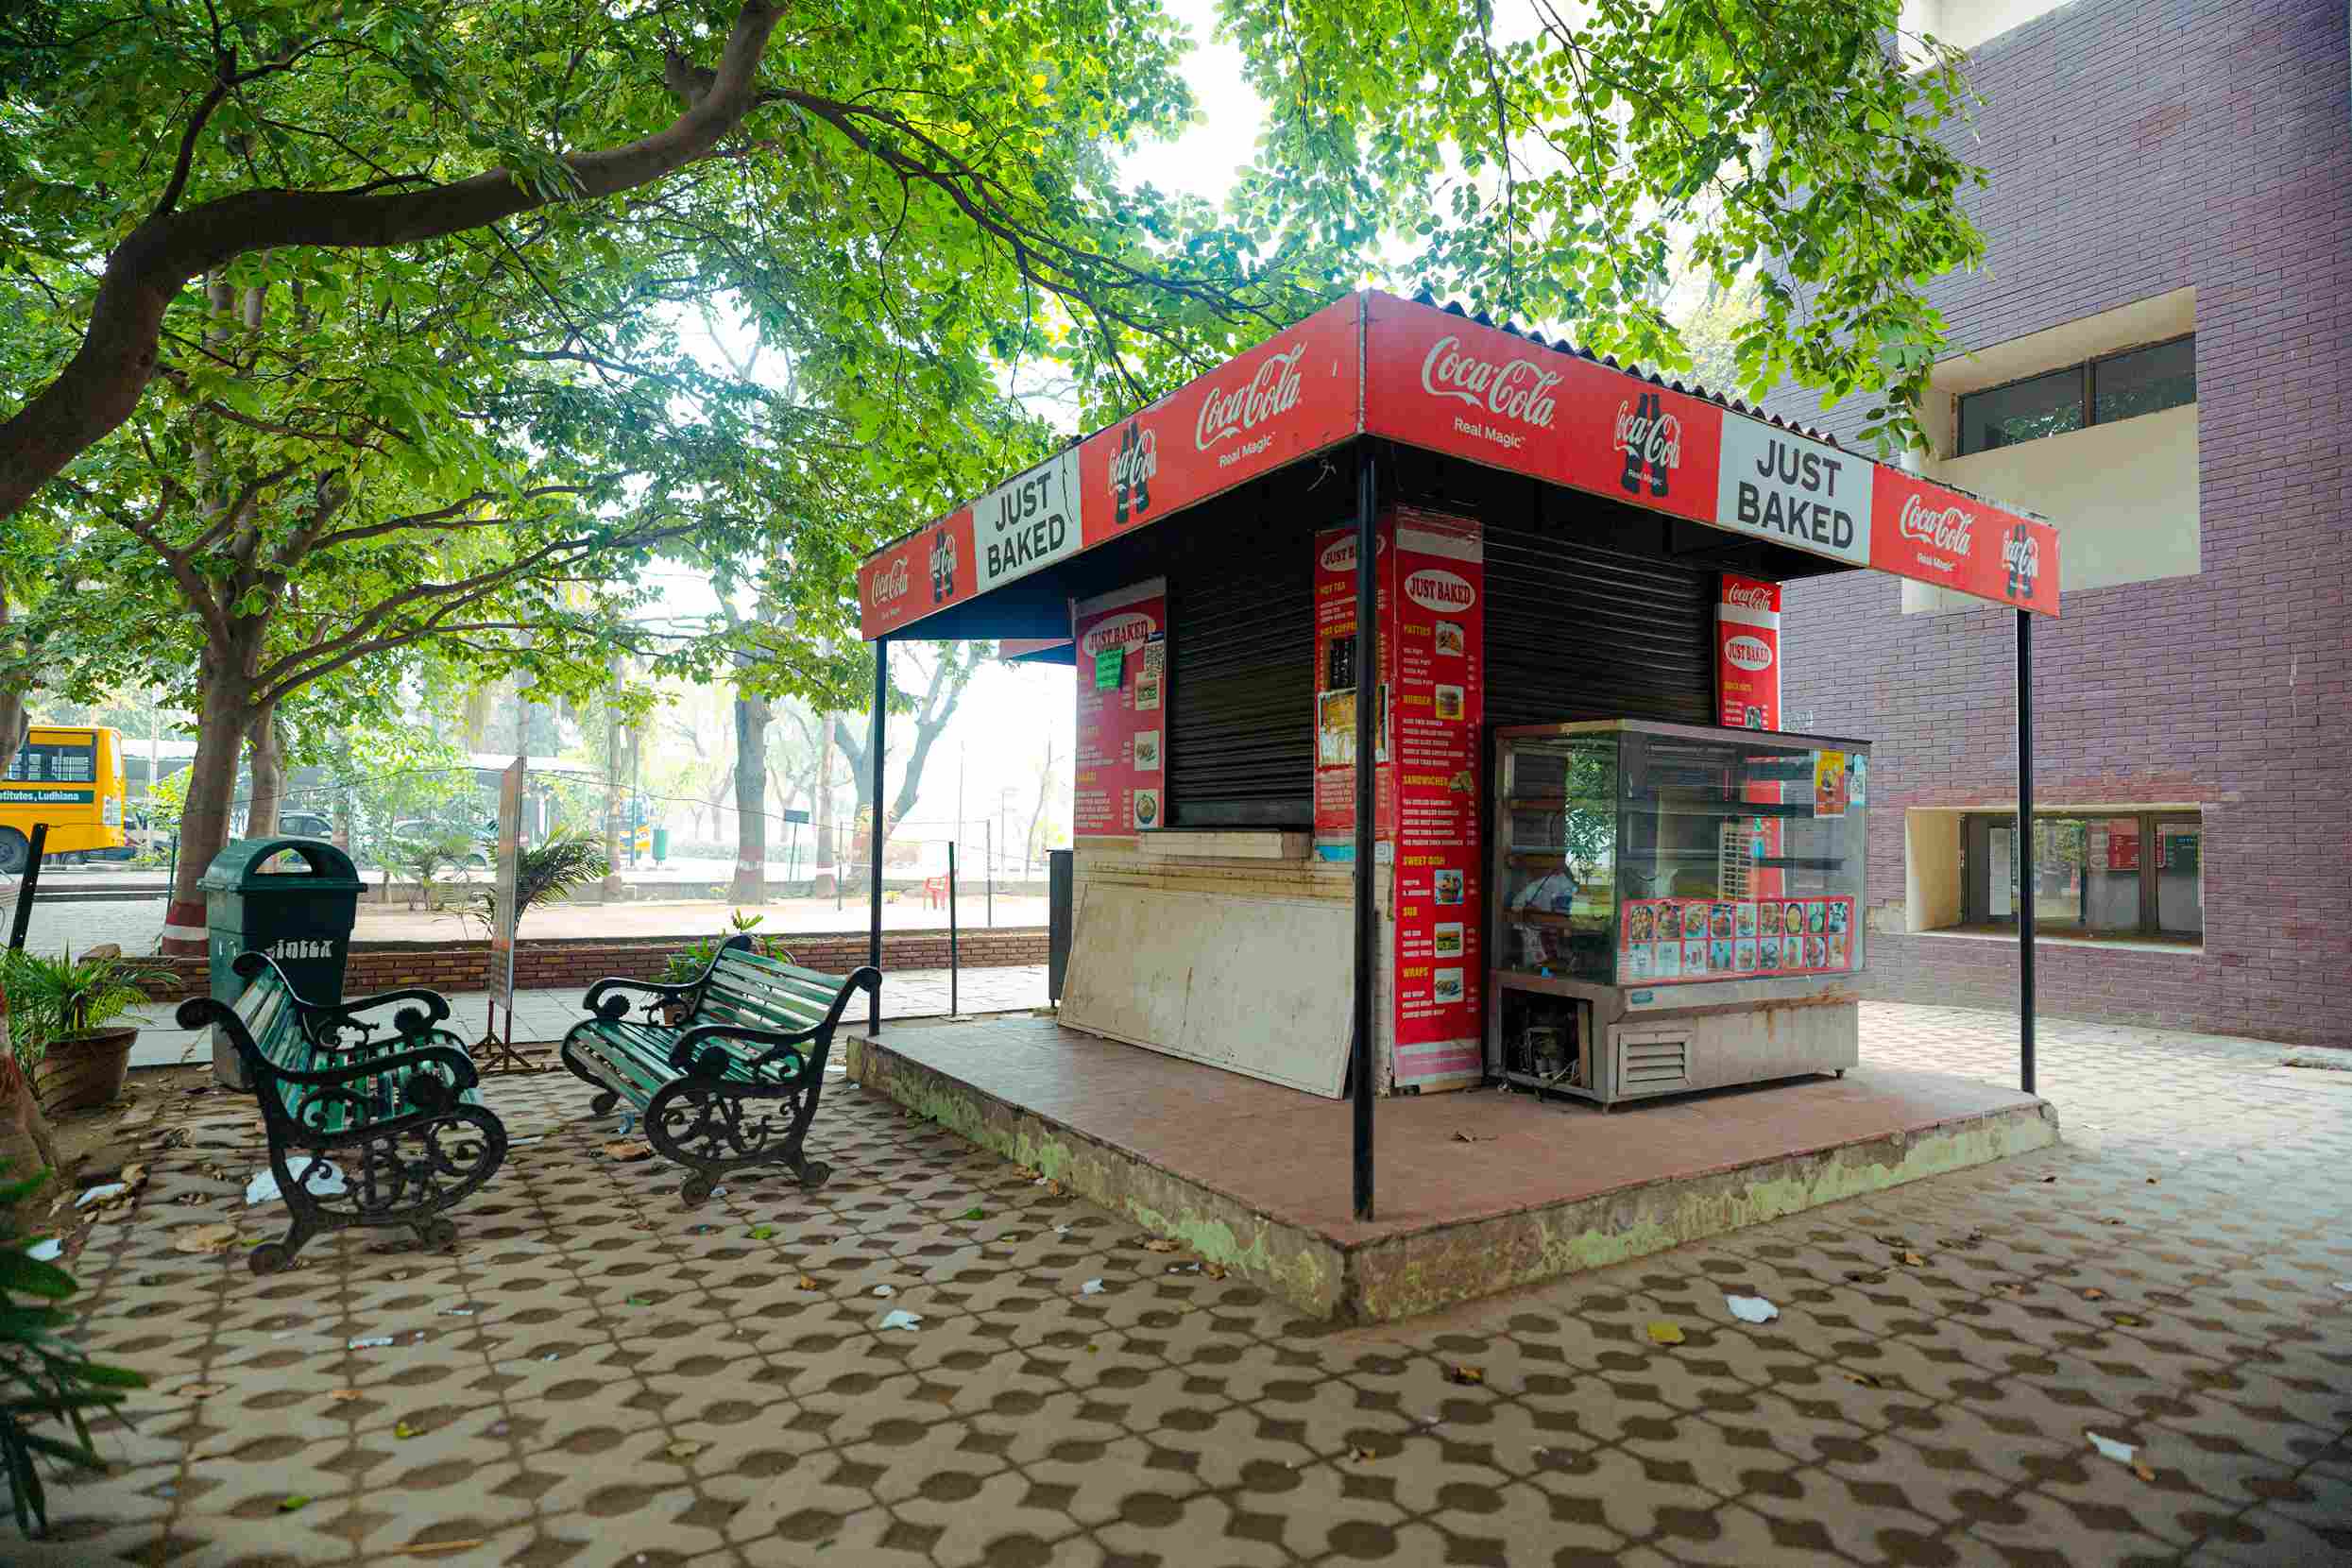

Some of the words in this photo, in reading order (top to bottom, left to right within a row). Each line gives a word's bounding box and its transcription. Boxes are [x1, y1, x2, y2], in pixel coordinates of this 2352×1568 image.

[1455, 415, 1481, 438] Real
[1484, 425, 1522, 450] Magic
[1219, 445, 1240, 469] Real
[1242, 434, 1271, 457] Magic
[1756, 439, 1842, 497] JUST
[995, 474, 1050, 532] JUST
[1738, 481, 1853, 549] BAKED
[988, 513, 1065, 578] BAKED
[1409, 577, 1436, 599] JUST
[1437, 581, 1471, 605] BAKED
[1729, 641, 1746, 660] JUST
[38, 791, 79, 801] Ludhiana
